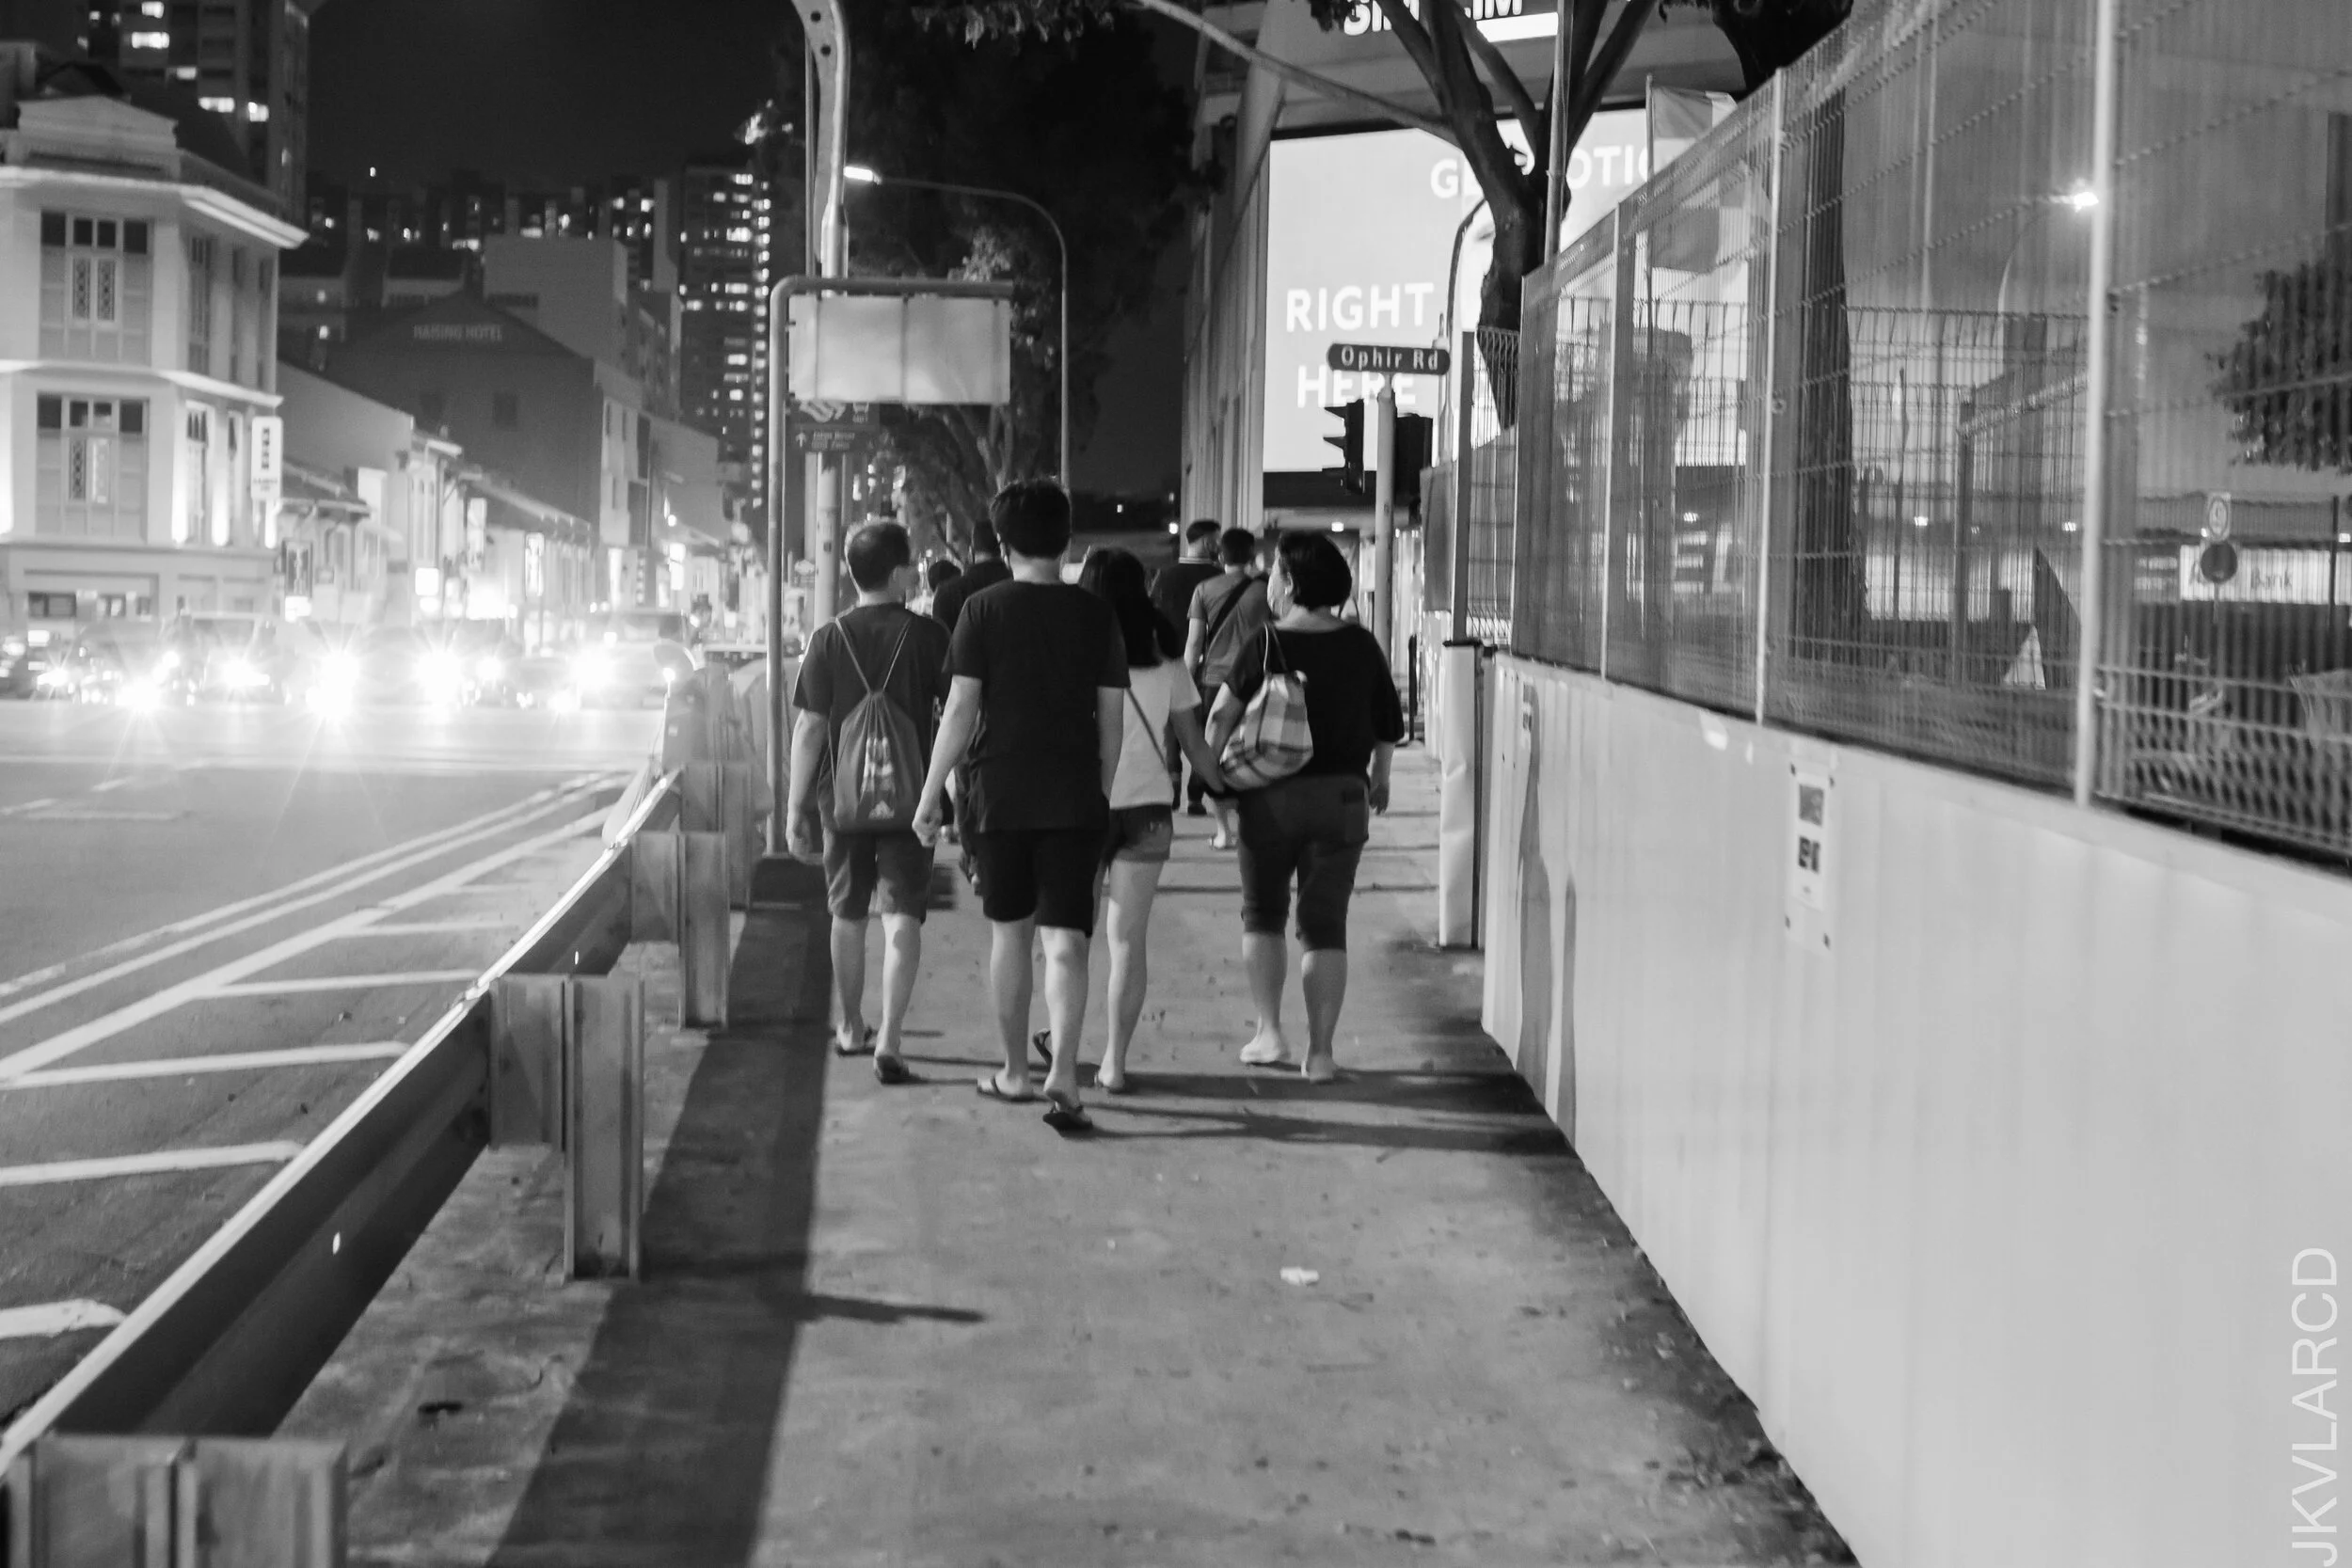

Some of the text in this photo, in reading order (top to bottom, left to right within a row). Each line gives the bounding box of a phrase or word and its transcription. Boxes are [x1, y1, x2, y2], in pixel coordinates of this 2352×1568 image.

[1286, 282, 1435, 333] RIGHT
[1341, 344, 1438, 372] Ophir Rd
